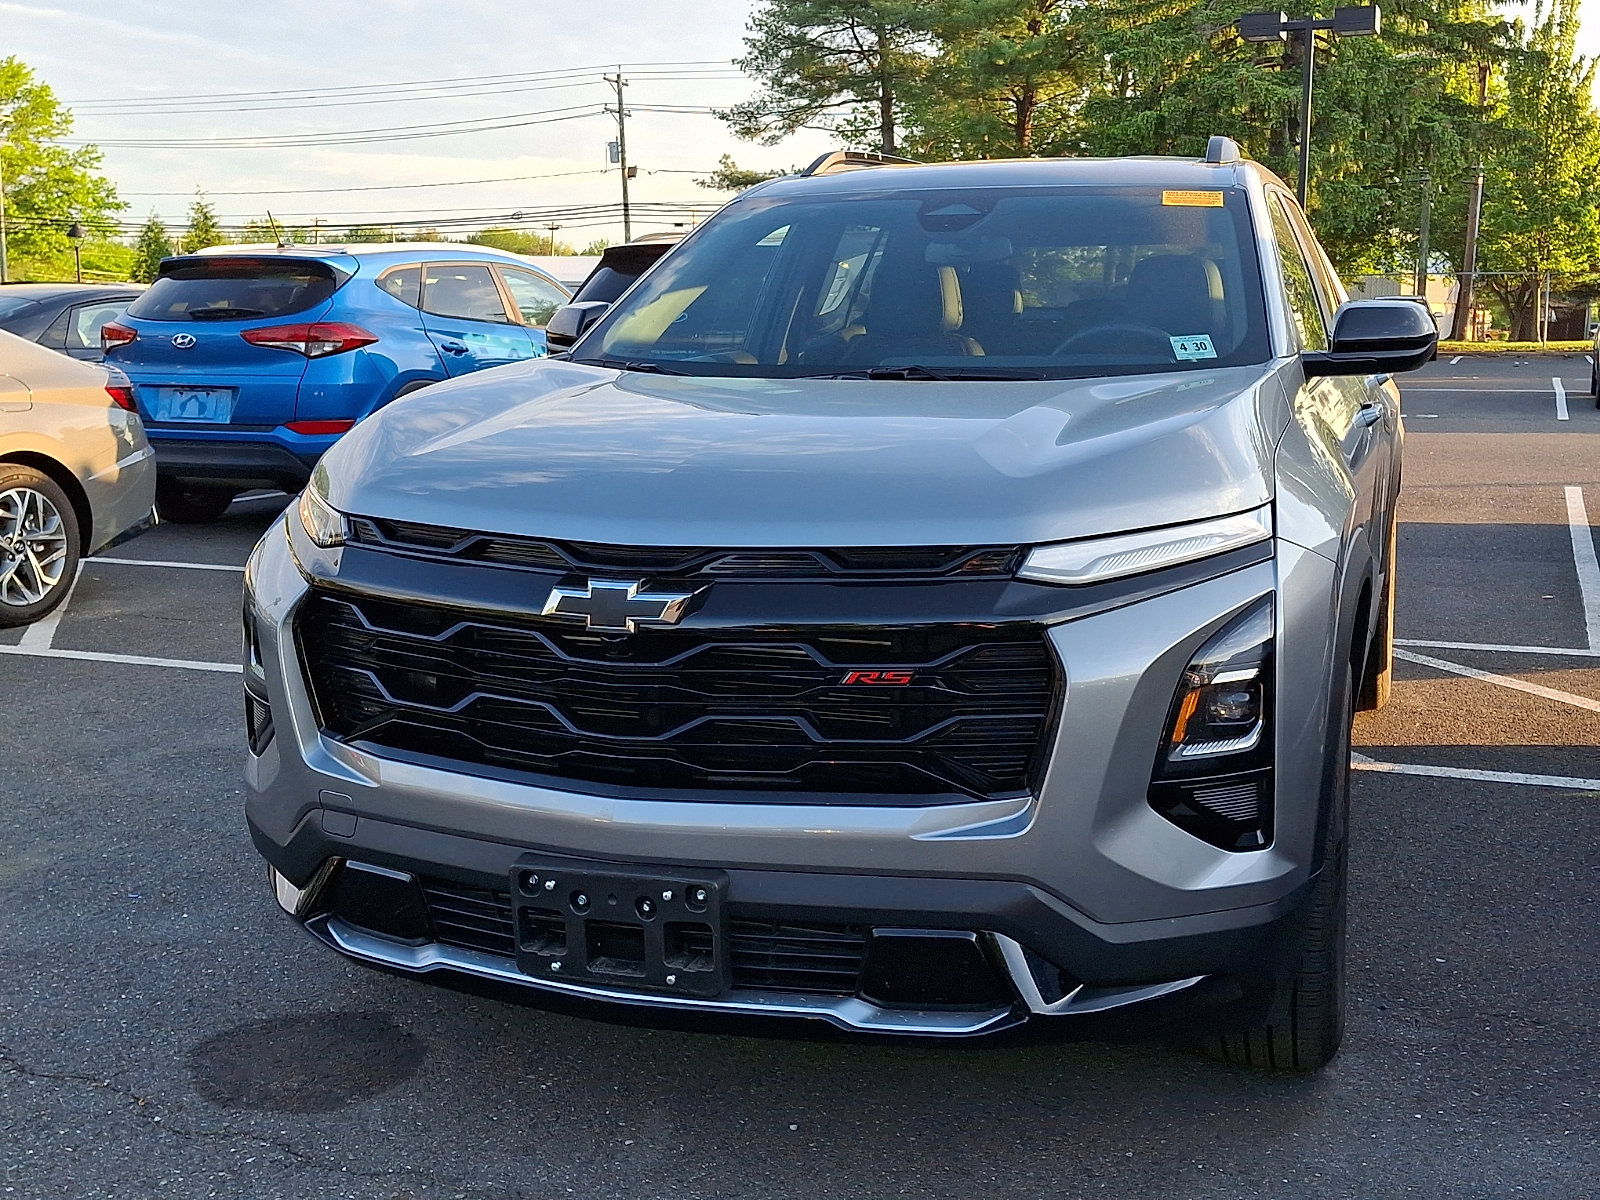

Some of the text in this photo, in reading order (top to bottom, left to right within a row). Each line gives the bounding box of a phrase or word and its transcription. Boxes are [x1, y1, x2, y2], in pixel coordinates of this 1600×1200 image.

[1180, 341, 1207, 352] 4 30
[842, 671, 915, 685] RS
